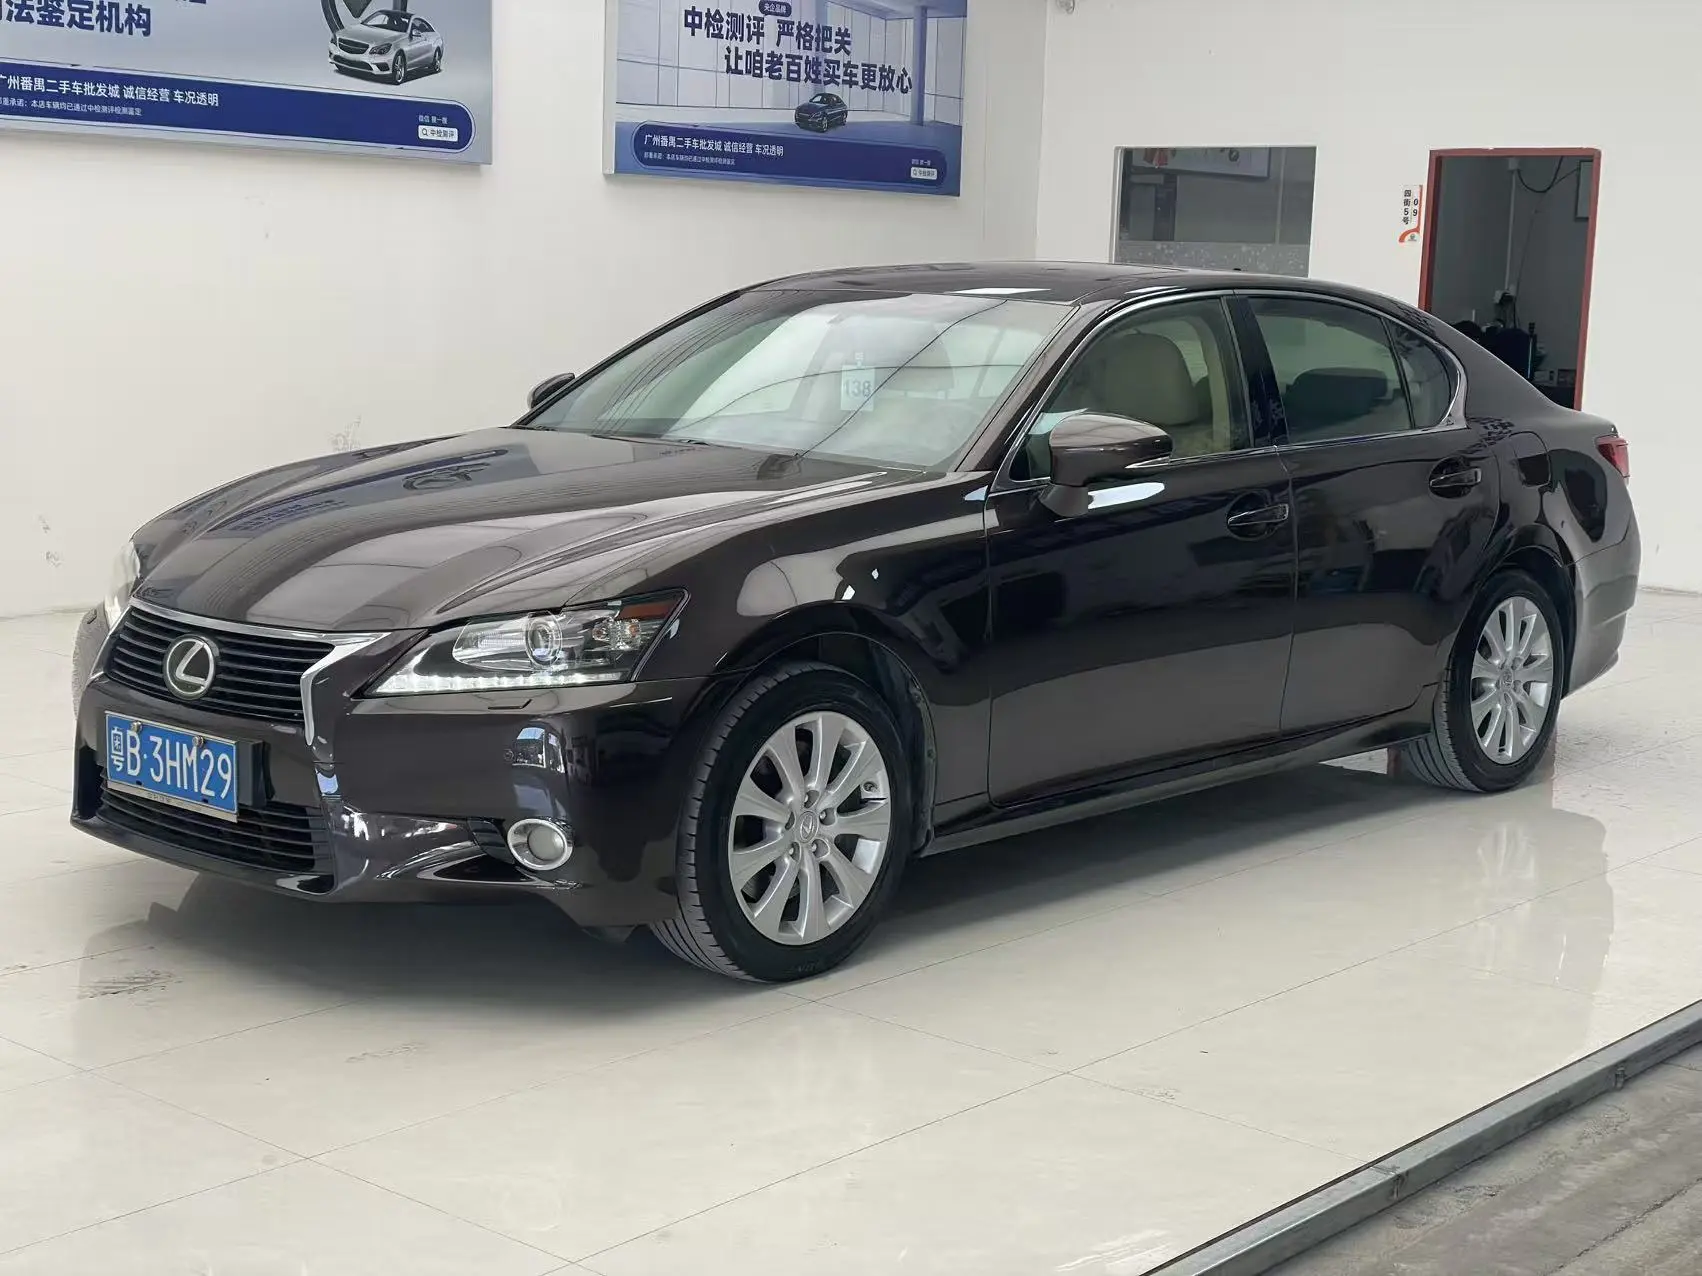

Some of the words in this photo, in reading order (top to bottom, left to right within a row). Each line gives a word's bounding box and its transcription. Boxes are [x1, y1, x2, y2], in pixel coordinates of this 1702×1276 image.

[0, 0, 151, 37] 法鉴定机构
[684, 6, 764, 45] 中检测评
[776, 19, 852, 56] 严格把关
[725, 45, 913, 94] 让咱老百姓买车更放心
[123, 85, 170, 103] 诚信经营
[173, 89, 219, 107] 车况透明
[644, 134, 722, 151] 广州番禺二手车批发城
[755, 144, 784, 156] 车况透明
[1402, 190, 1411, 225] 四街5号
